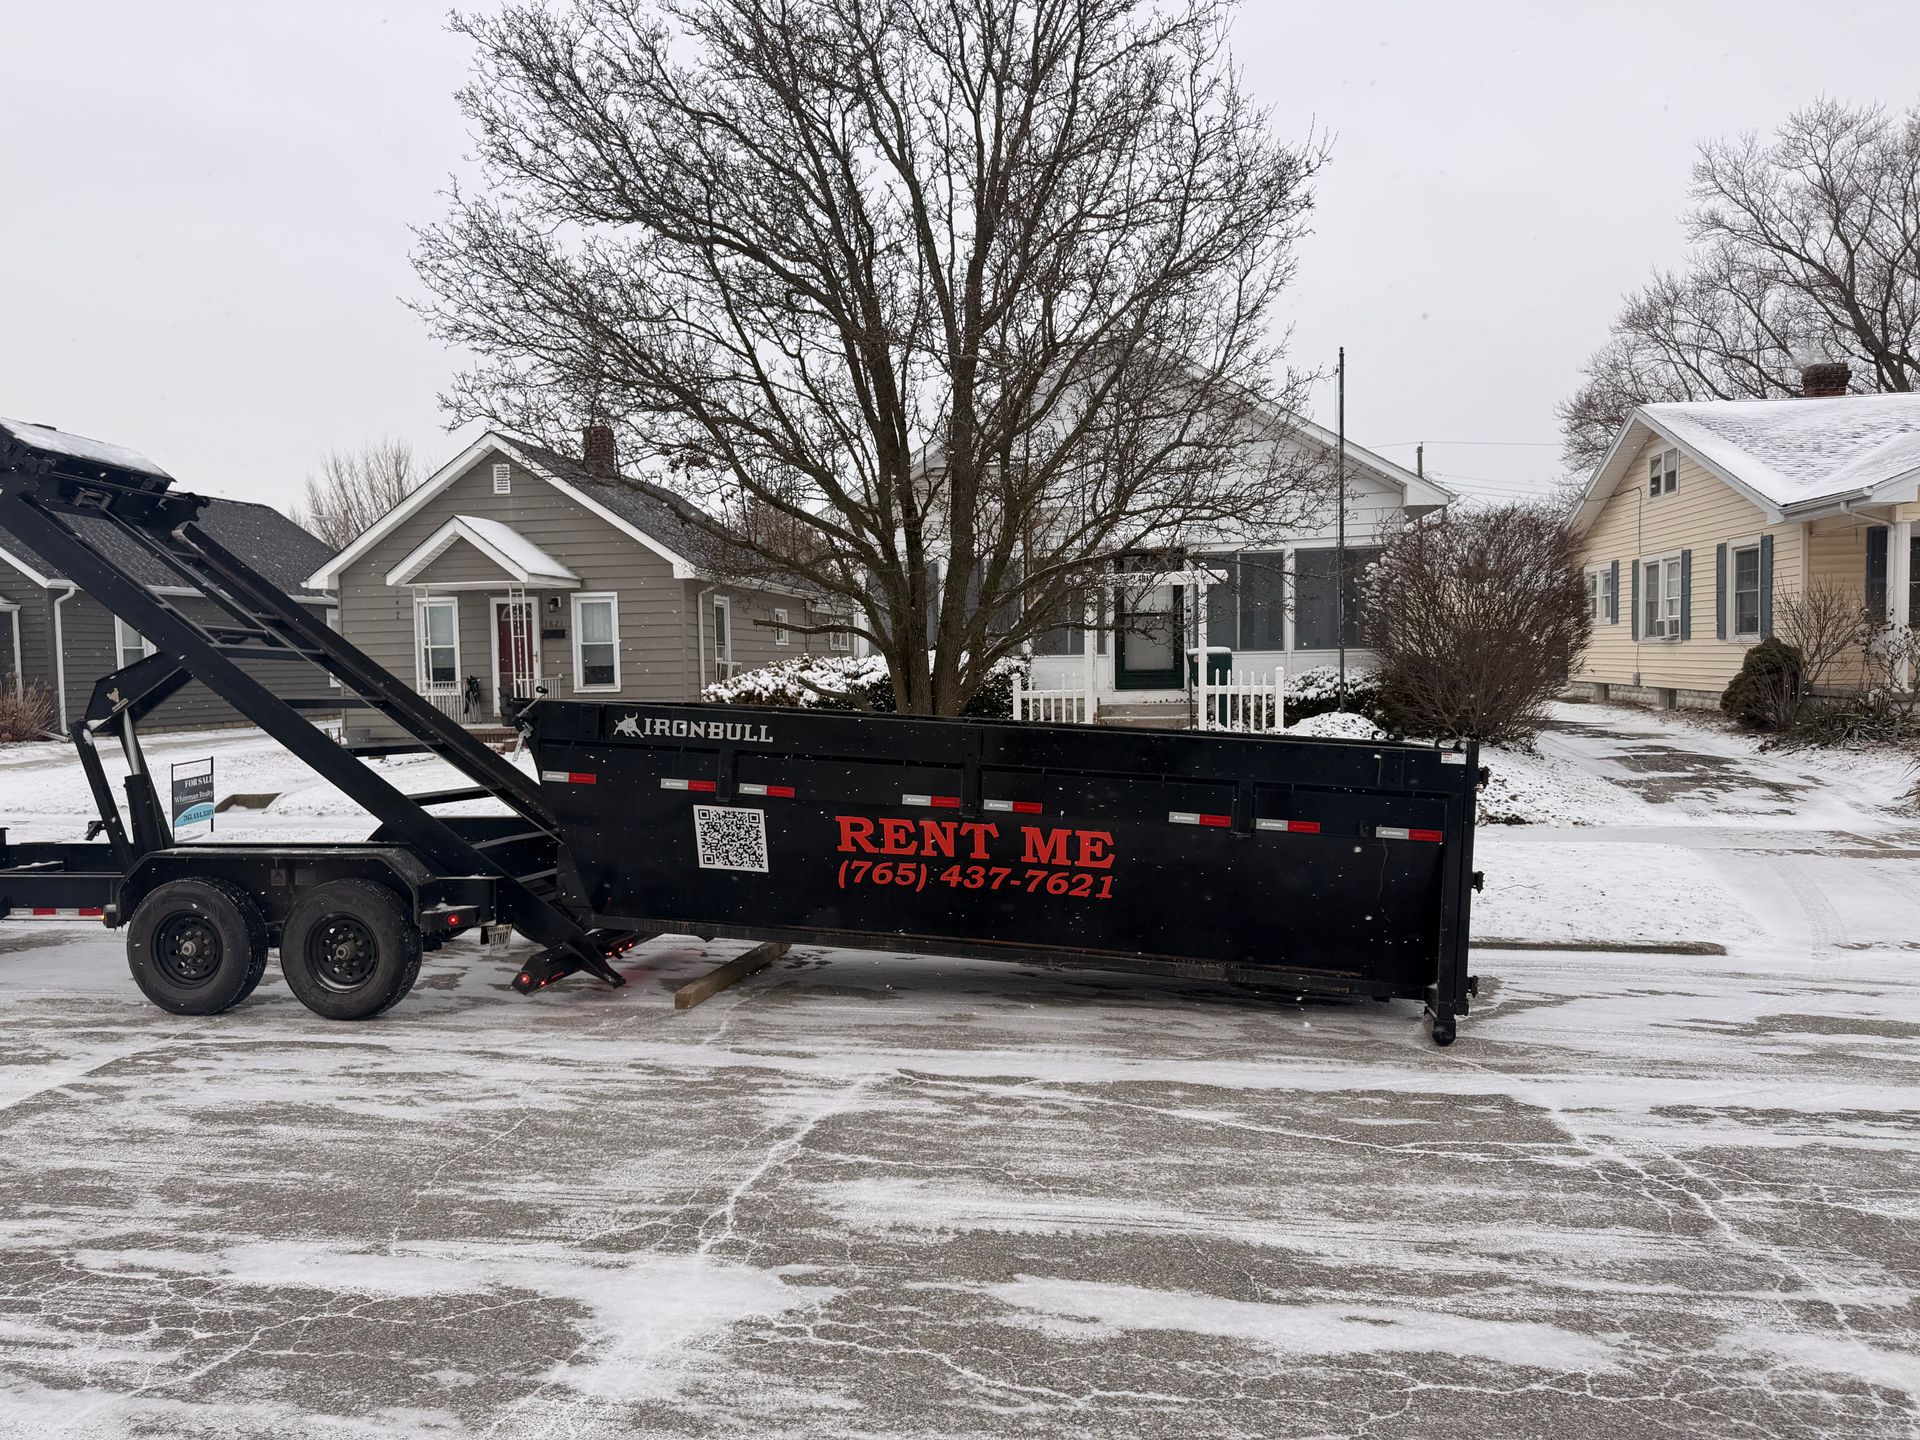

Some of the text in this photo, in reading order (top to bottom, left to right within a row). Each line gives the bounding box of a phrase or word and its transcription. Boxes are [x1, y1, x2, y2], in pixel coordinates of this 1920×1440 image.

[643, 718, 774, 743] IRONBULL
[184, 775, 213, 788] FOR SALE
[835, 815, 1115, 869] RENT ME
[837, 859, 1114, 899] (765) 437-7621
